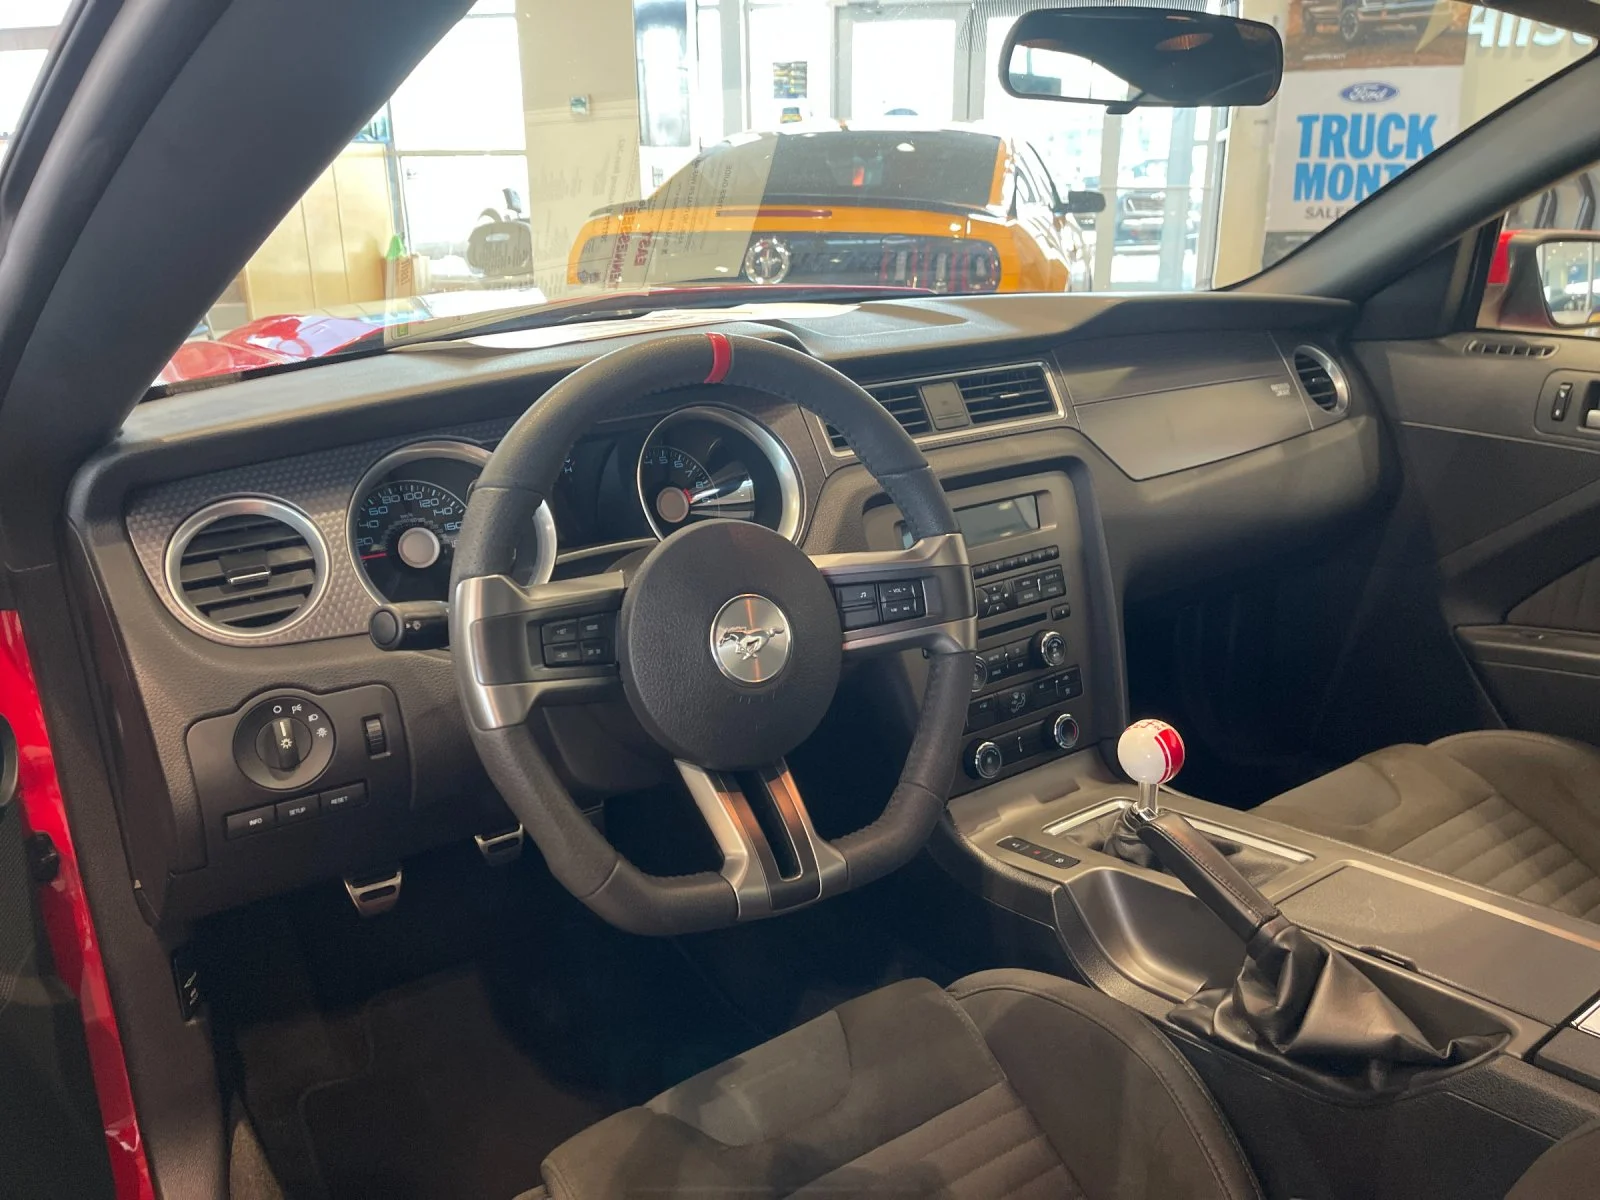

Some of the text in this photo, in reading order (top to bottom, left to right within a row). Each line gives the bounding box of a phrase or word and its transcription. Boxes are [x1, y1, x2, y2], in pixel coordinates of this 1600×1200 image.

[1297, 113, 1437, 160] TRUCK
[1304, 205, 1353, 220] SALE
[381, 494, 401, 504] 80
[403, 491, 423, 501] 100
[419, 498, 439, 508] 120
[368, 506, 388, 516] 60
[433, 507, 453, 517] 140
[330, 796, 348, 804] RESET
[288, 807, 306, 816] SETUP
[249, 817, 263, 826] INFO
